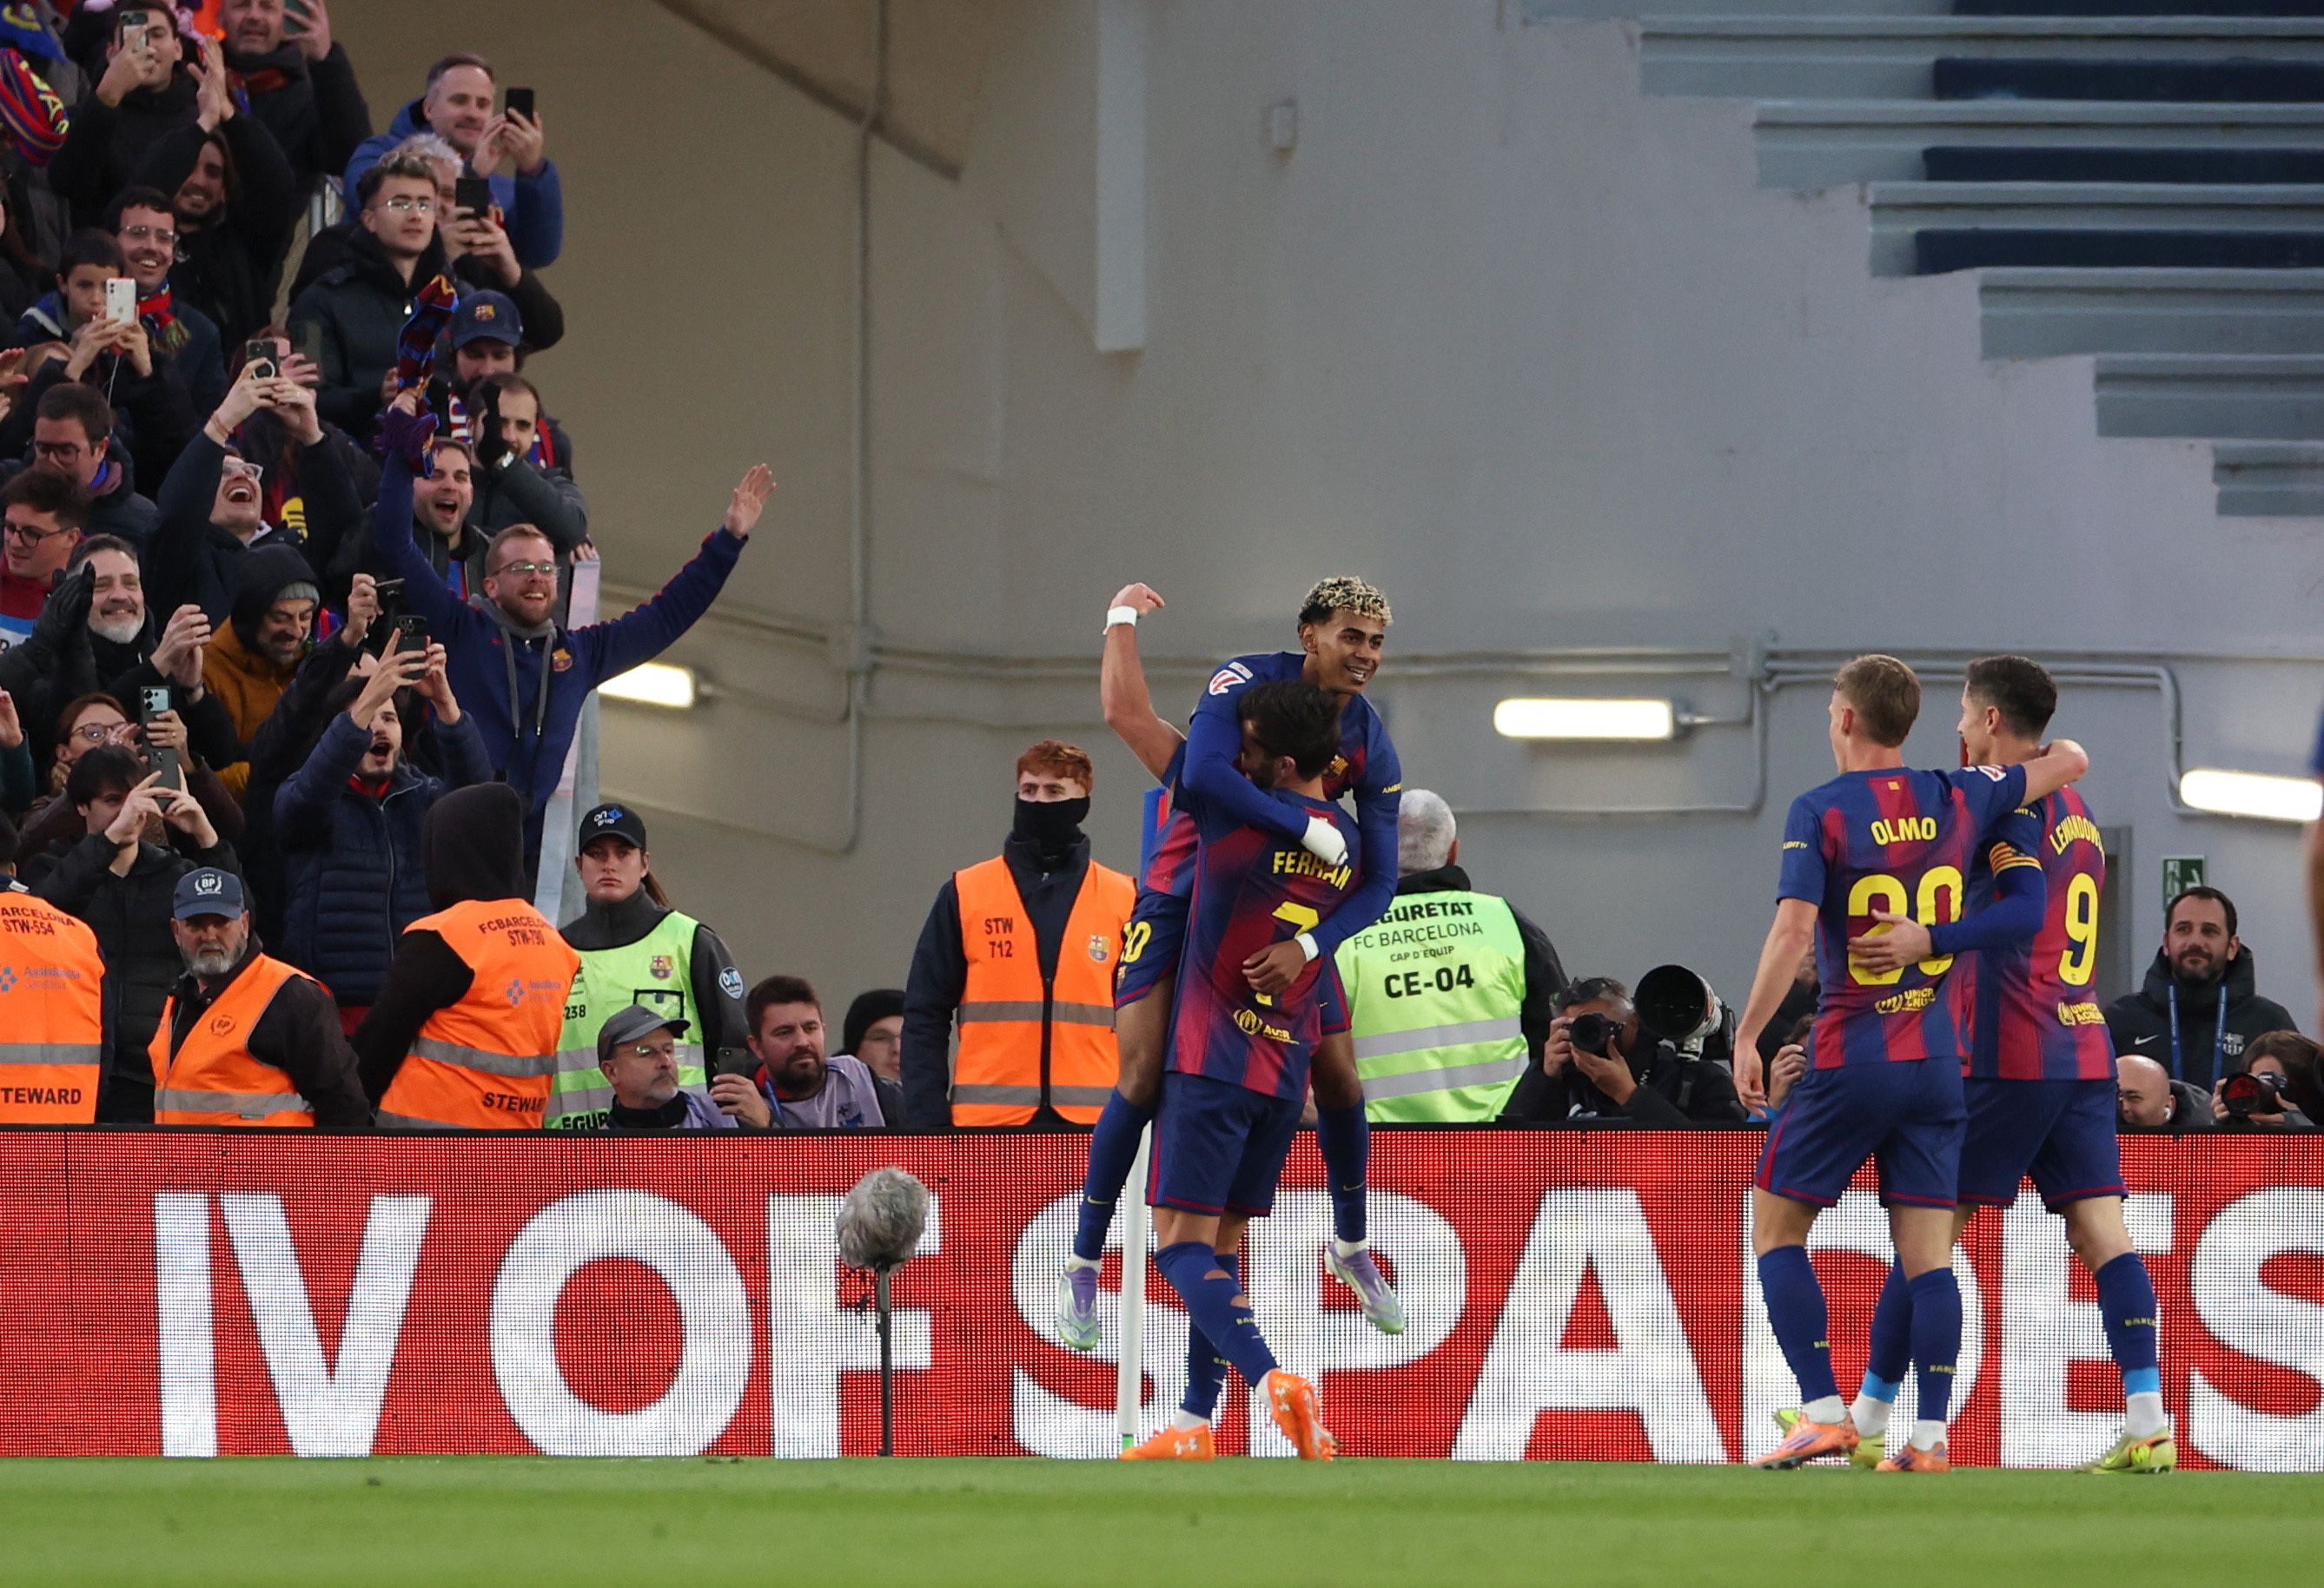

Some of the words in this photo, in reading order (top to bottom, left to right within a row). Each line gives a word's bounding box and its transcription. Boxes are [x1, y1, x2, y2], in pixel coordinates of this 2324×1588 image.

[1870, 817, 1937, 846] OLMO
[201, 877, 216, 889] BP
[984, 917, 1014, 935] STW
[1373, 902, 1473, 926] GURETAT
[3, 919, 56, 936] STW-554
[1354, 935, 1374, 950] FC
[1379, 922, 1484, 948] BARCELONA
[2058, 872, 2099, 986] 9
[989, 941, 1013, 958] 712
[1390, 953, 1410, 963] CAP
[1384, 963, 1475, 999] CE-04
[154, 1191, 432, 1458] IV
[489, 1188, 940, 1459] OF
[1010, 1185, 2324, 1473] SPADES
